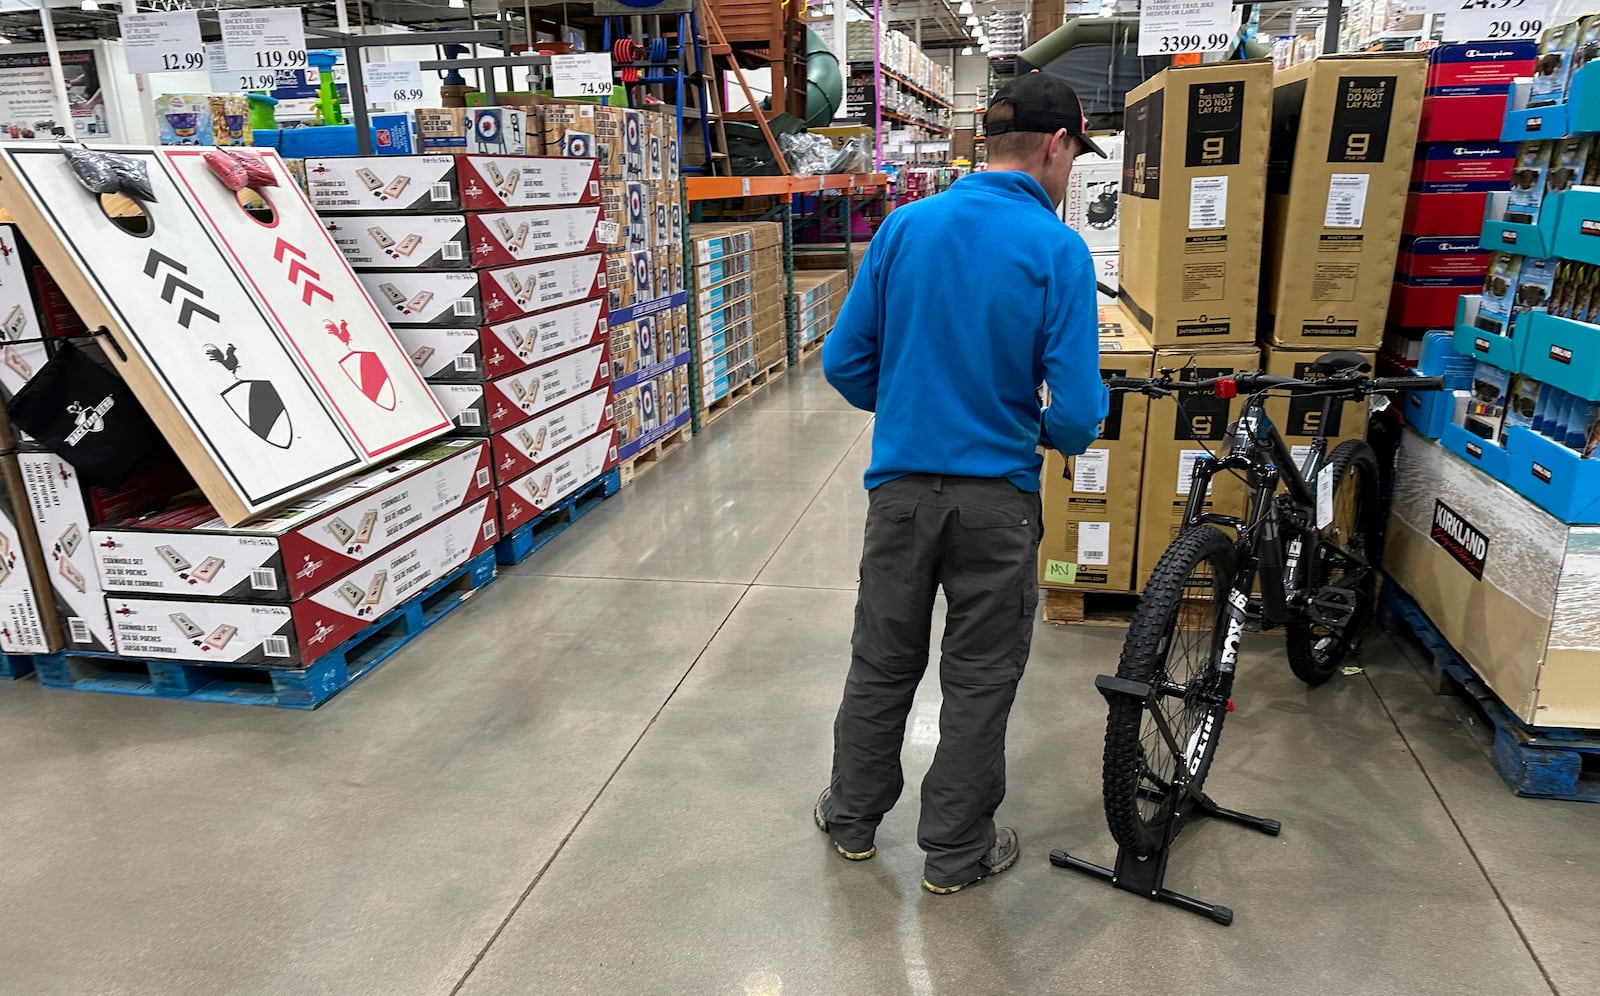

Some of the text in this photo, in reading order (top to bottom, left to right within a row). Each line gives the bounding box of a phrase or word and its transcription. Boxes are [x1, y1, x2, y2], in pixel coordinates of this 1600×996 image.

[1488, 20, 1542, 38] 29.99
[1159, 32, 1228, 52] 3399.99
[162, 52, 204, 70] 12.99
[255, 50, 307, 68] 119.99
[1465, 49, 1514, 59] Champion
[240, 74, 275, 89] 21.99
[580, 82, 612, 94] 74.99
[394, 88, 423, 100] 68.99
[1214, 97, 1234, 106] NOT
[1363, 93, 1384, 101] NOT
[1452, 147, 1501, 156] Champion
[1069, 172, 1077, 229] ONDORS
[1435, 505, 1486, 560] KIRKLAND
[1050, 564, 1069, 575] MV
[1228, 587, 1248, 608] 36
